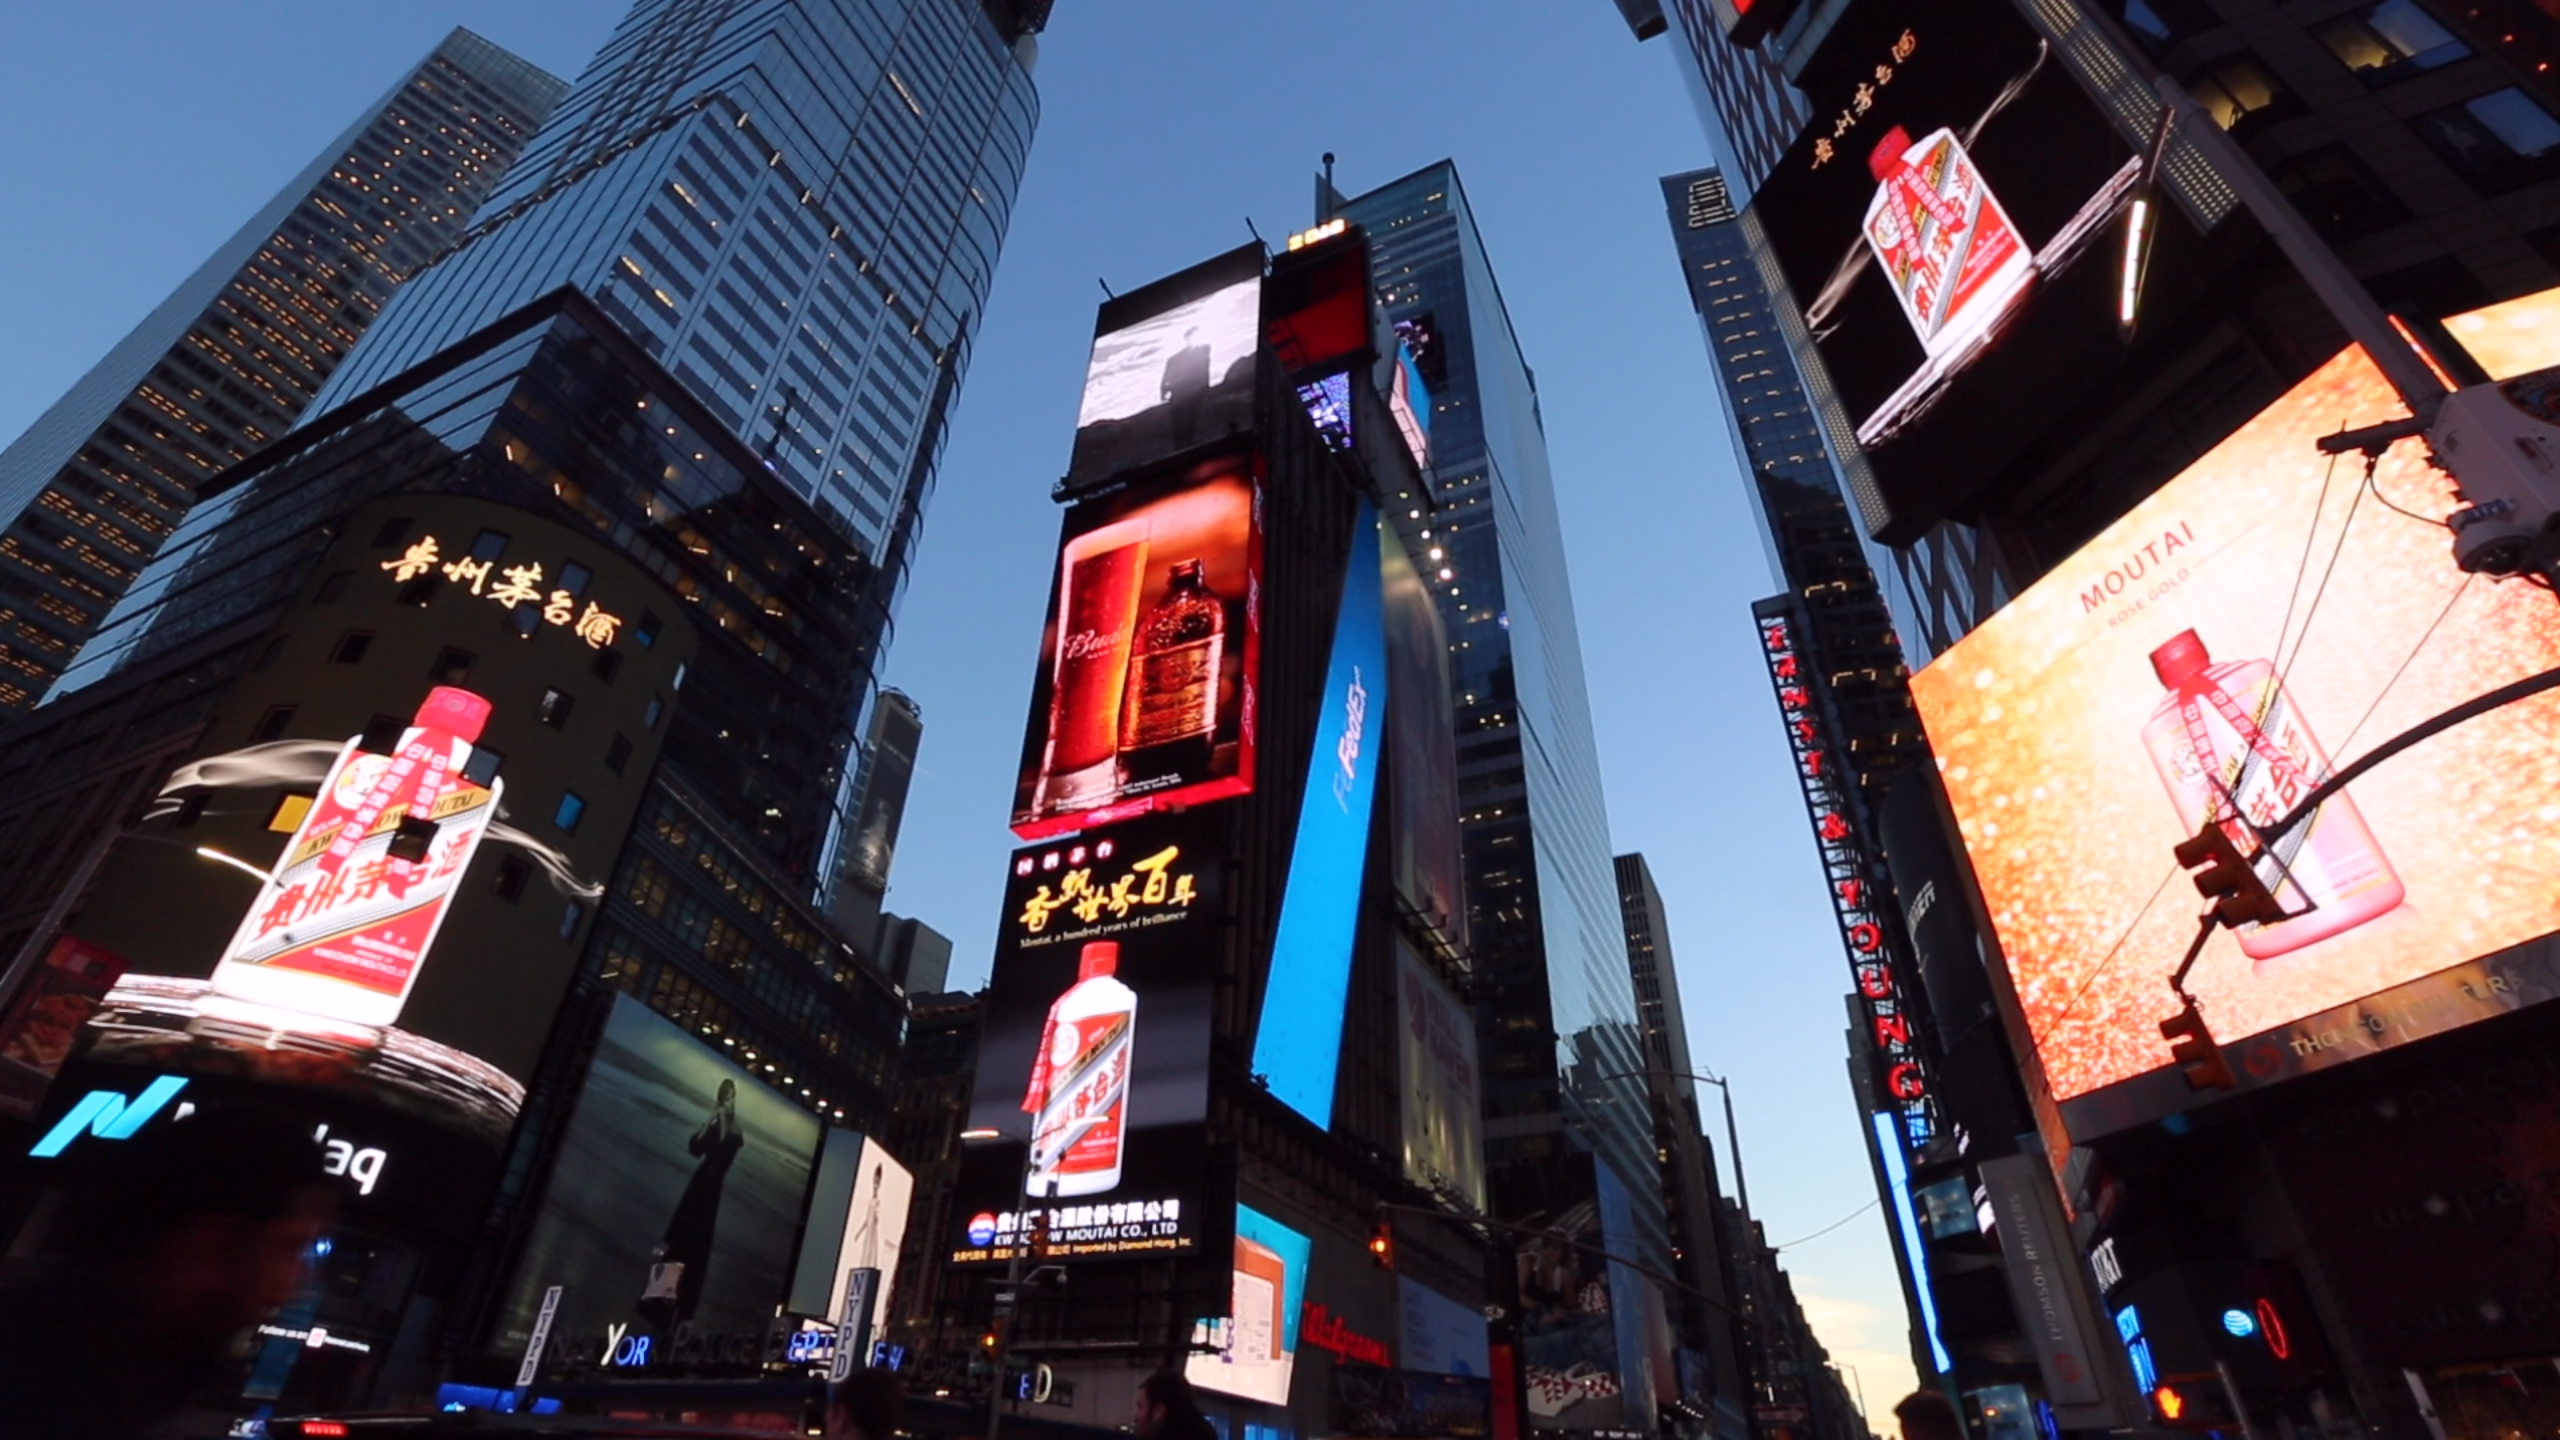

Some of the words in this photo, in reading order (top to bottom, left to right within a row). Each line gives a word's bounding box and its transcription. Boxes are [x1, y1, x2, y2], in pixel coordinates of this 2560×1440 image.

[2080, 520, 2195, 614] MOUTAI
[2108, 598, 2145, 629] ROSE
[2148, 568, 2190, 602] GOLD
[1766, 625, 1824, 776] ERNST
[1821, 812, 1849, 840] &
[1837, 879, 1925, 1100] YOUNG
[1063, 924, 1101, 941] hundred
[1102, 921, 1128, 937] years
[1130, 916, 1141, 929] of
[1066, 1226, 1118, 1242] MOUTAI
[1152, 1221, 1178, 1237] LTD
[517, 1287, 563, 1385] NYPD
[830, 1271, 867, 1382] NYPD
[1303, 1301, 1392, 1368] Walgreens
[2031, 1265, 2063, 1342] THOMSON
